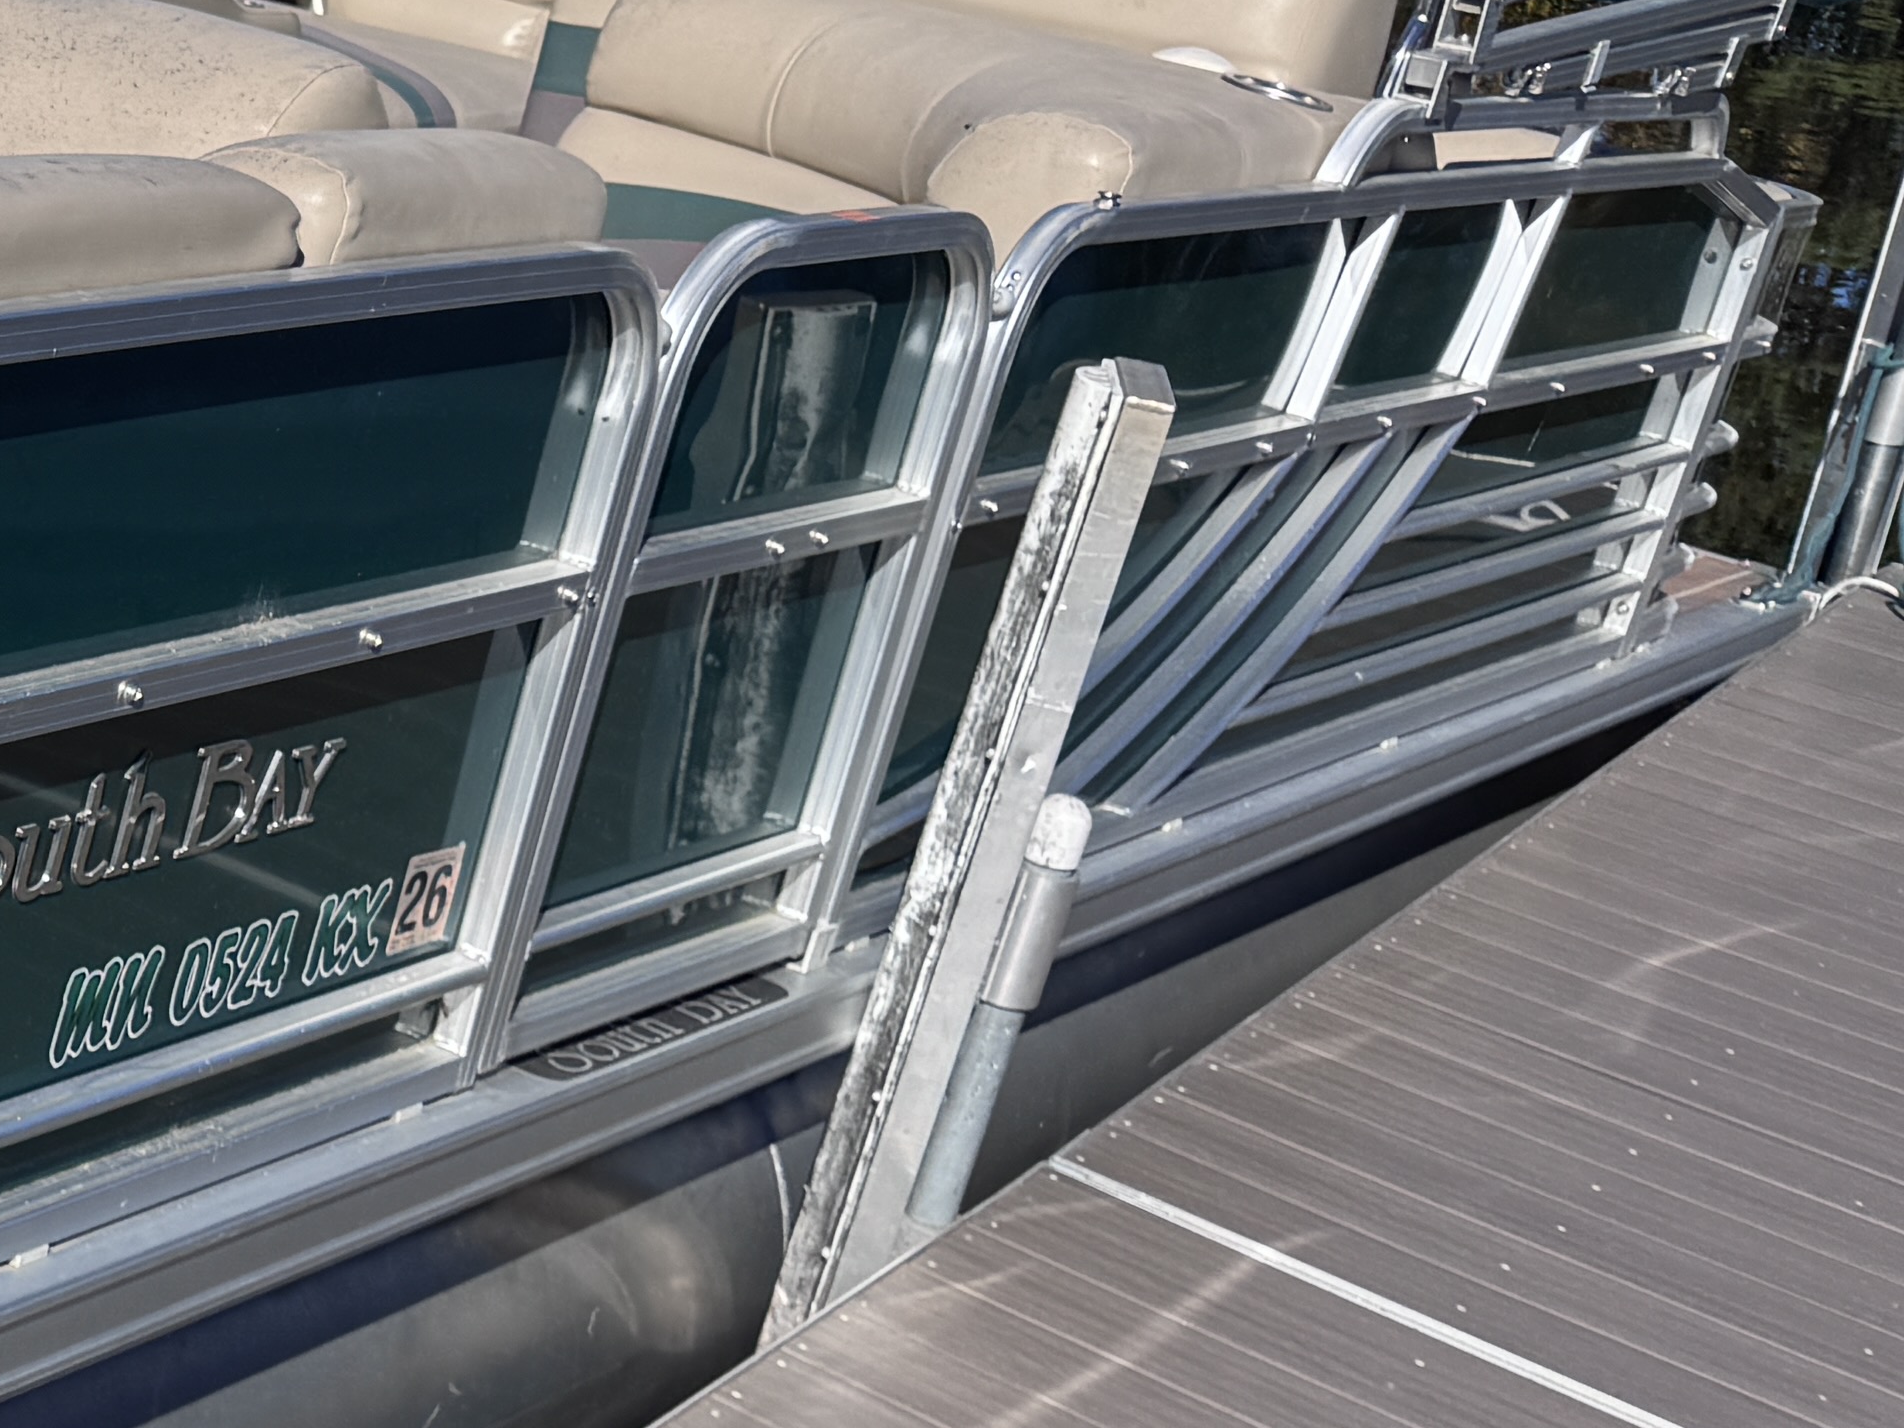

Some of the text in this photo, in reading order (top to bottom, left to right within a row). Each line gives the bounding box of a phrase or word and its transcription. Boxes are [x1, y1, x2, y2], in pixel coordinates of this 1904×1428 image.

[172, 737, 348, 860] BAY
[394, 863, 453, 936] 26
[49, 877, 394, 1069] MN 0524 KX
